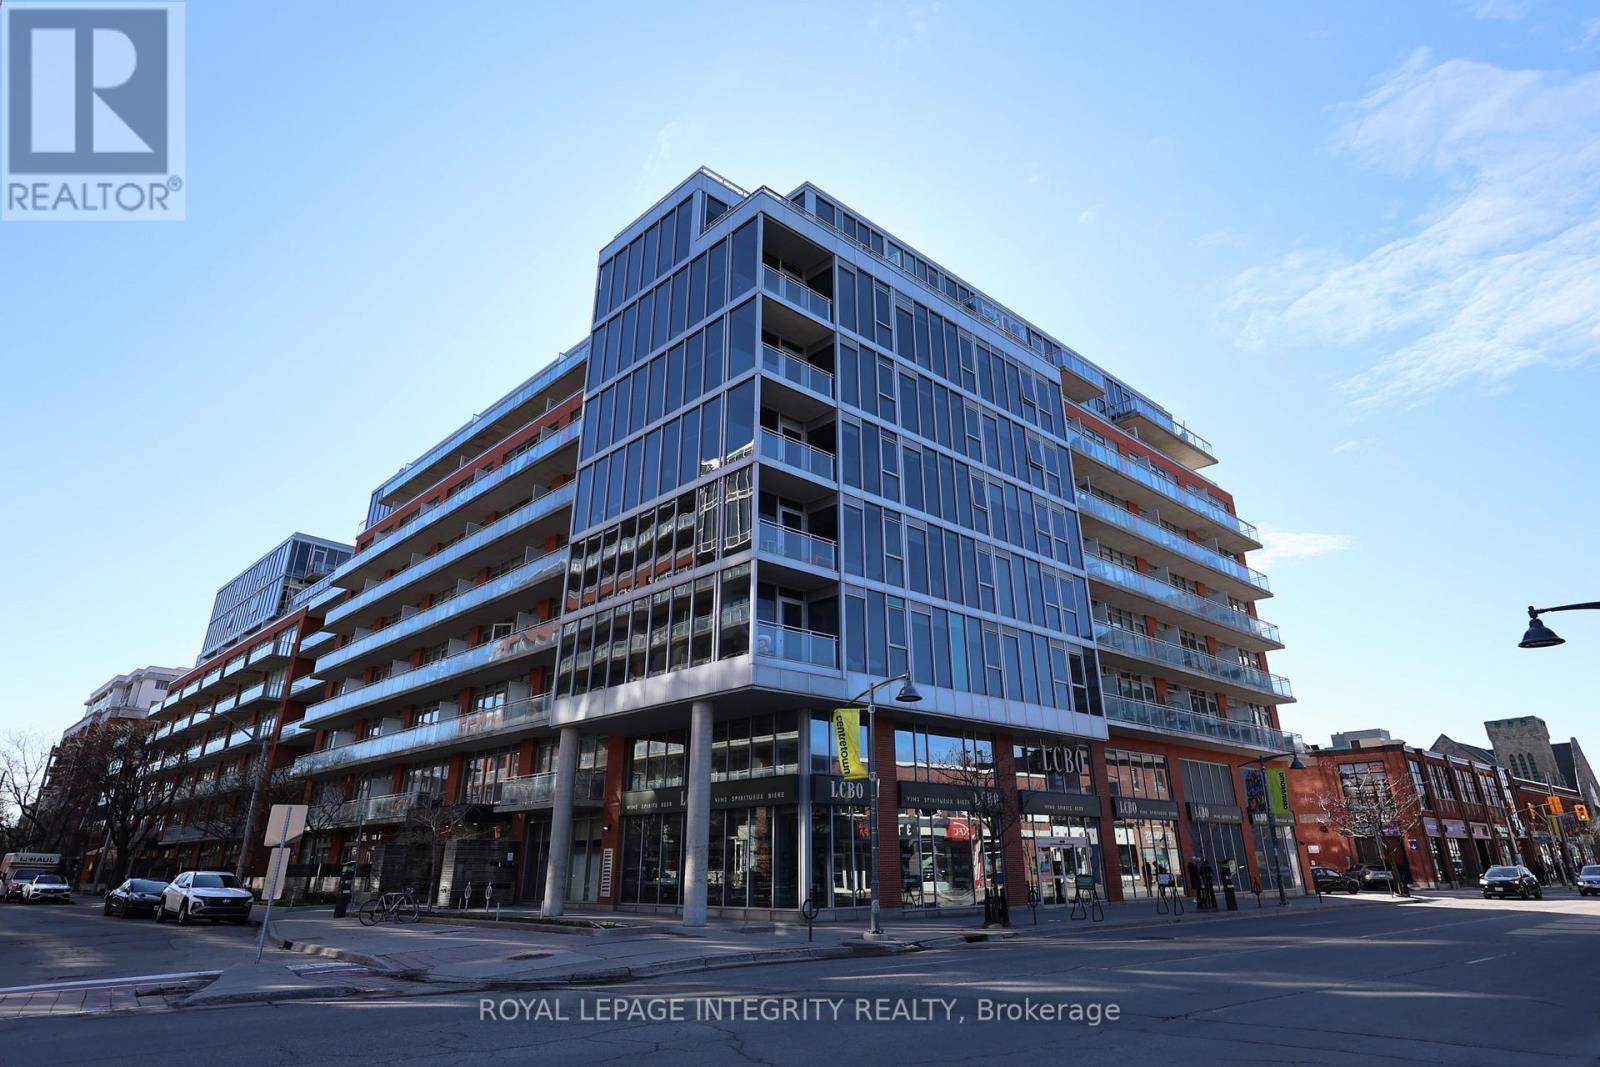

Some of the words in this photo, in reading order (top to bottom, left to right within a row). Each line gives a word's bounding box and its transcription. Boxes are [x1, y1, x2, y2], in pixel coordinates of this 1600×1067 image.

[836, 715, 851, 775] centretown
[1042, 744, 1085, 774] LCBO
[831, 780, 864, 799] LCBO
